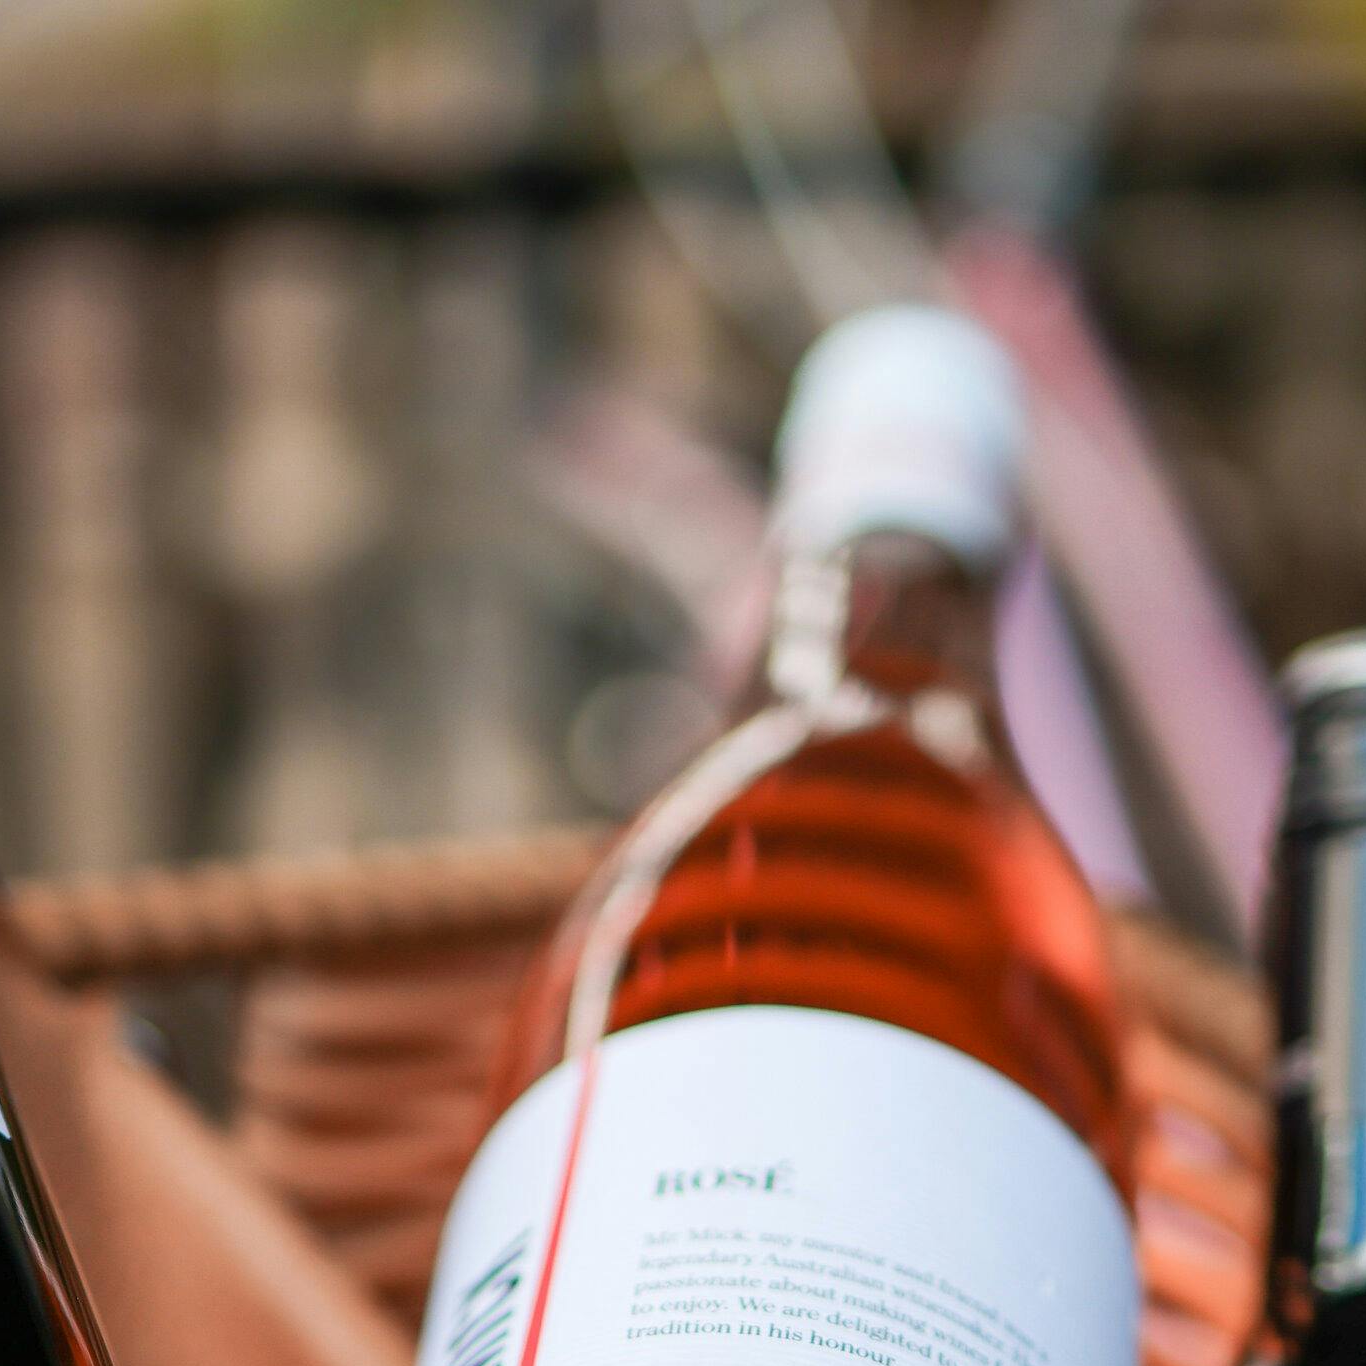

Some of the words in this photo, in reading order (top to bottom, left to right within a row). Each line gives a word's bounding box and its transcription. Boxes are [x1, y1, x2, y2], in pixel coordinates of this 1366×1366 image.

[651, 1158, 795, 1196] ROSÉ
[631, 1300, 654, 1315] to
[660, 1296, 729, 1314] enjoy.
[738, 1296, 776, 1313] We
[782, 1304, 819, 1321] are
[826, 1311, 932, 1358] delighted
[633, 1274, 762, 1295] passionate
[767, 1276, 837, 1300] about
[842, 1293, 926, 1332] making
[627, 1319, 731, 1340] tradition
[739, 1319, 761, 1336] in
[768, 1323, 803, 1342] his
